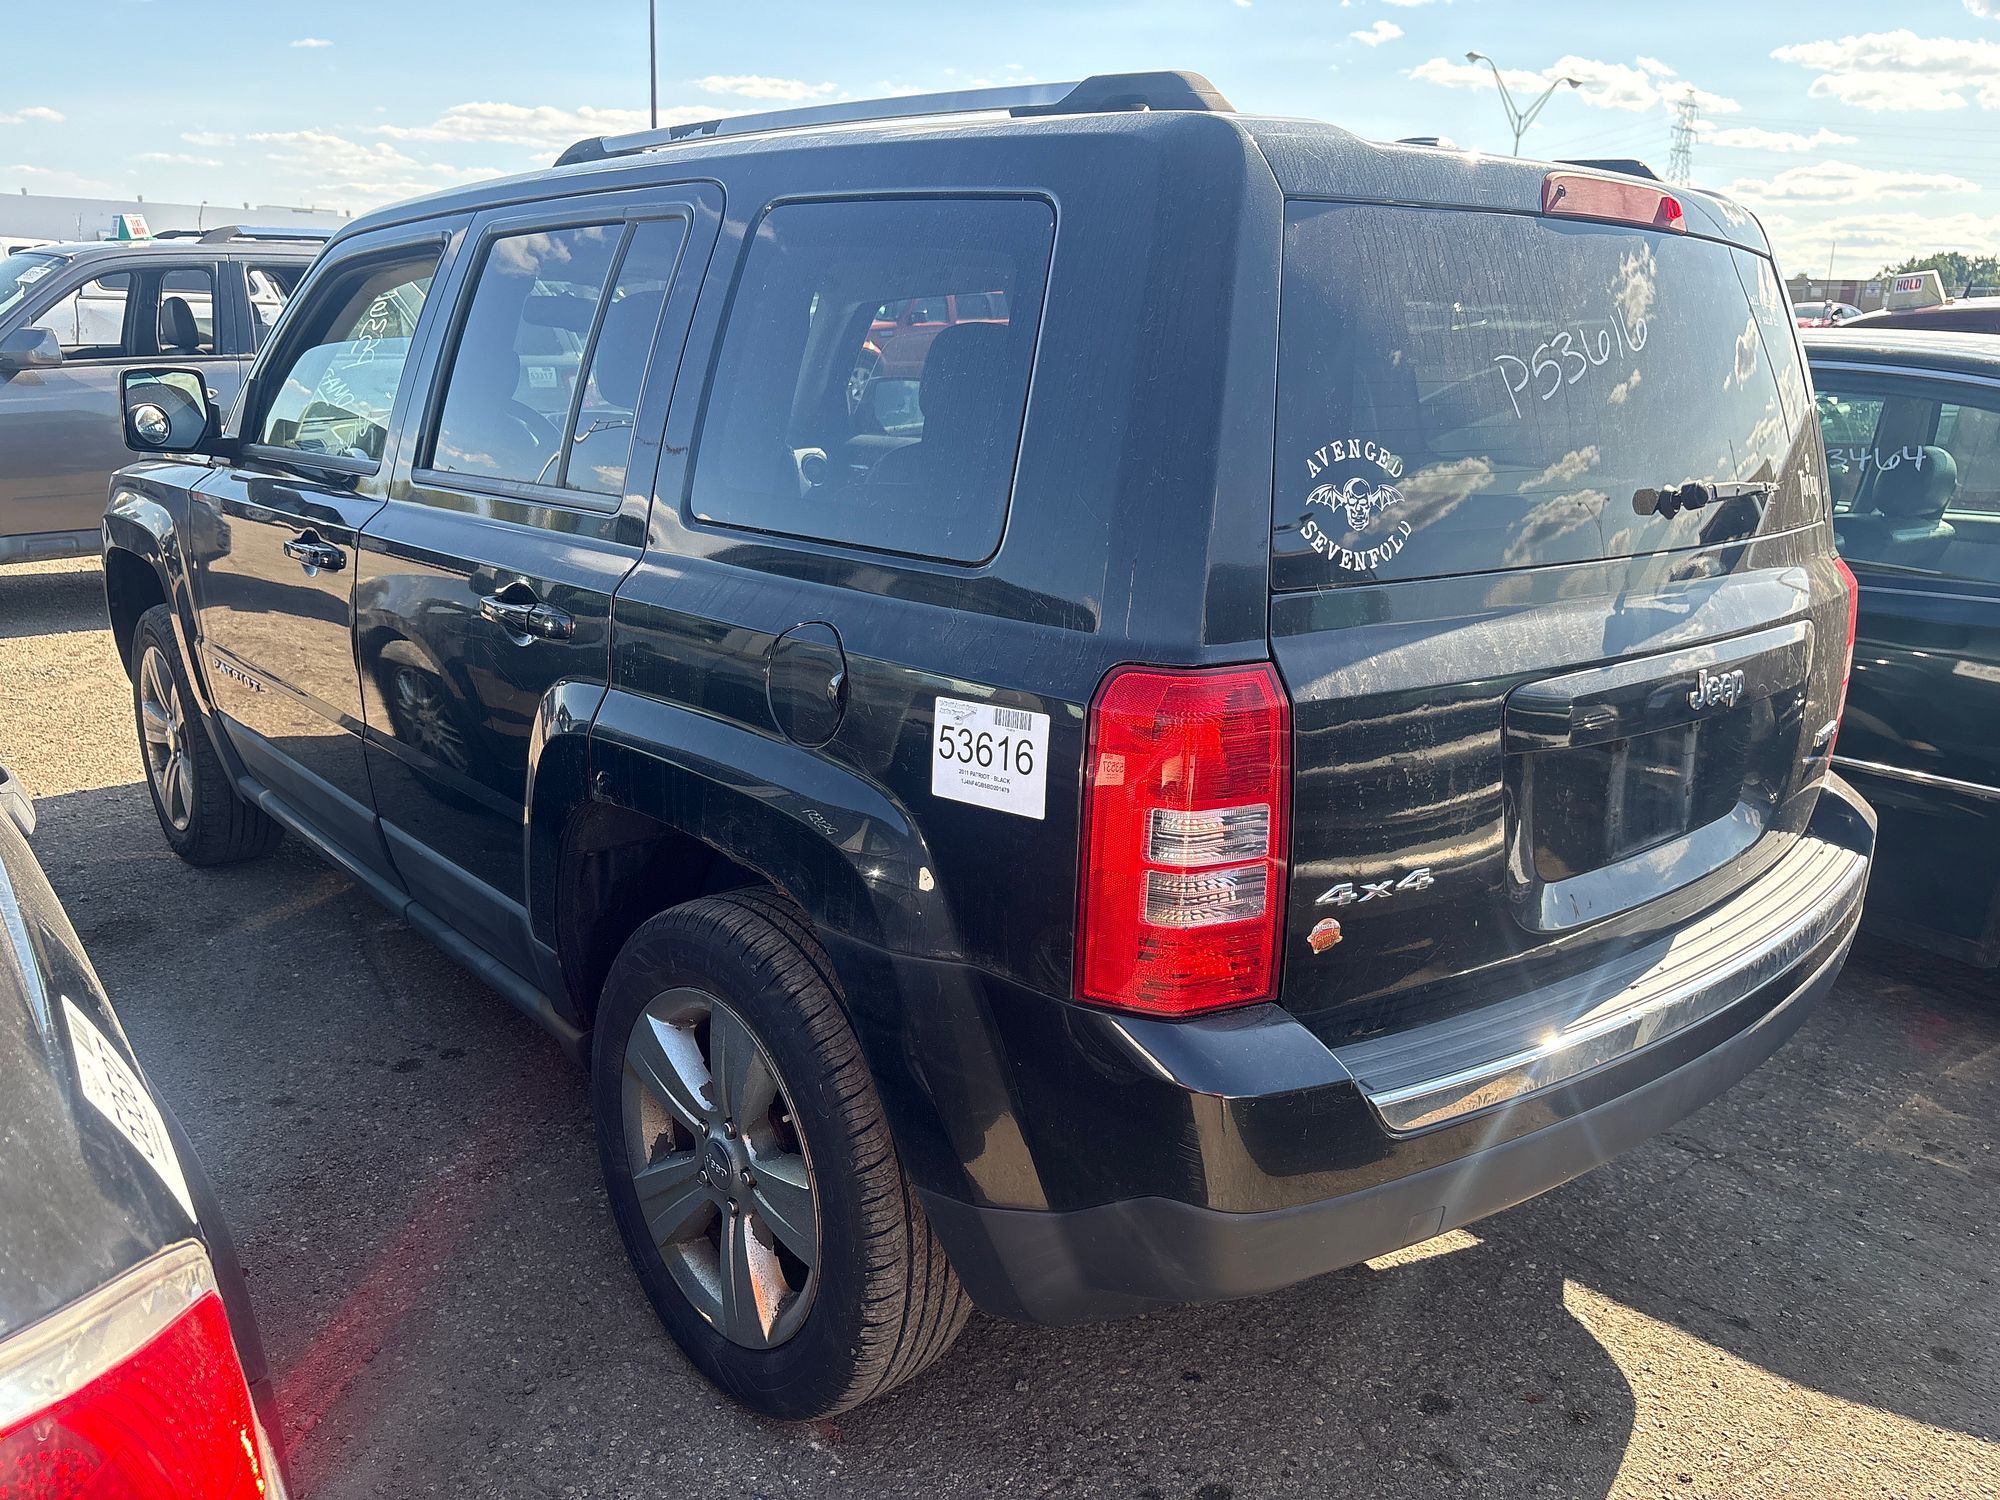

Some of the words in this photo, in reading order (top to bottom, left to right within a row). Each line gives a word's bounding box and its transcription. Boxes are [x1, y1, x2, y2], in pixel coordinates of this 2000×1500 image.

[1895, 278, 1922, 292] HOLD
[1494, 307, 1648, 419] P53616
[1306, 439, 1403, 479] AVENGED
[1300, 520, 1412, 571] SEVENFOLD
[212, 657, 261, 693] PATRIOT
[1687, 668, 1745, 711] Jeep
[938, 724, 1034, 776] 53616
[958, 768, 969, 776] 2011
[969, 770, 990, 780] PATRIOT
[993, 775, 1011, 785] BLACK
[705, 1152, 728, 1177] Jeep
